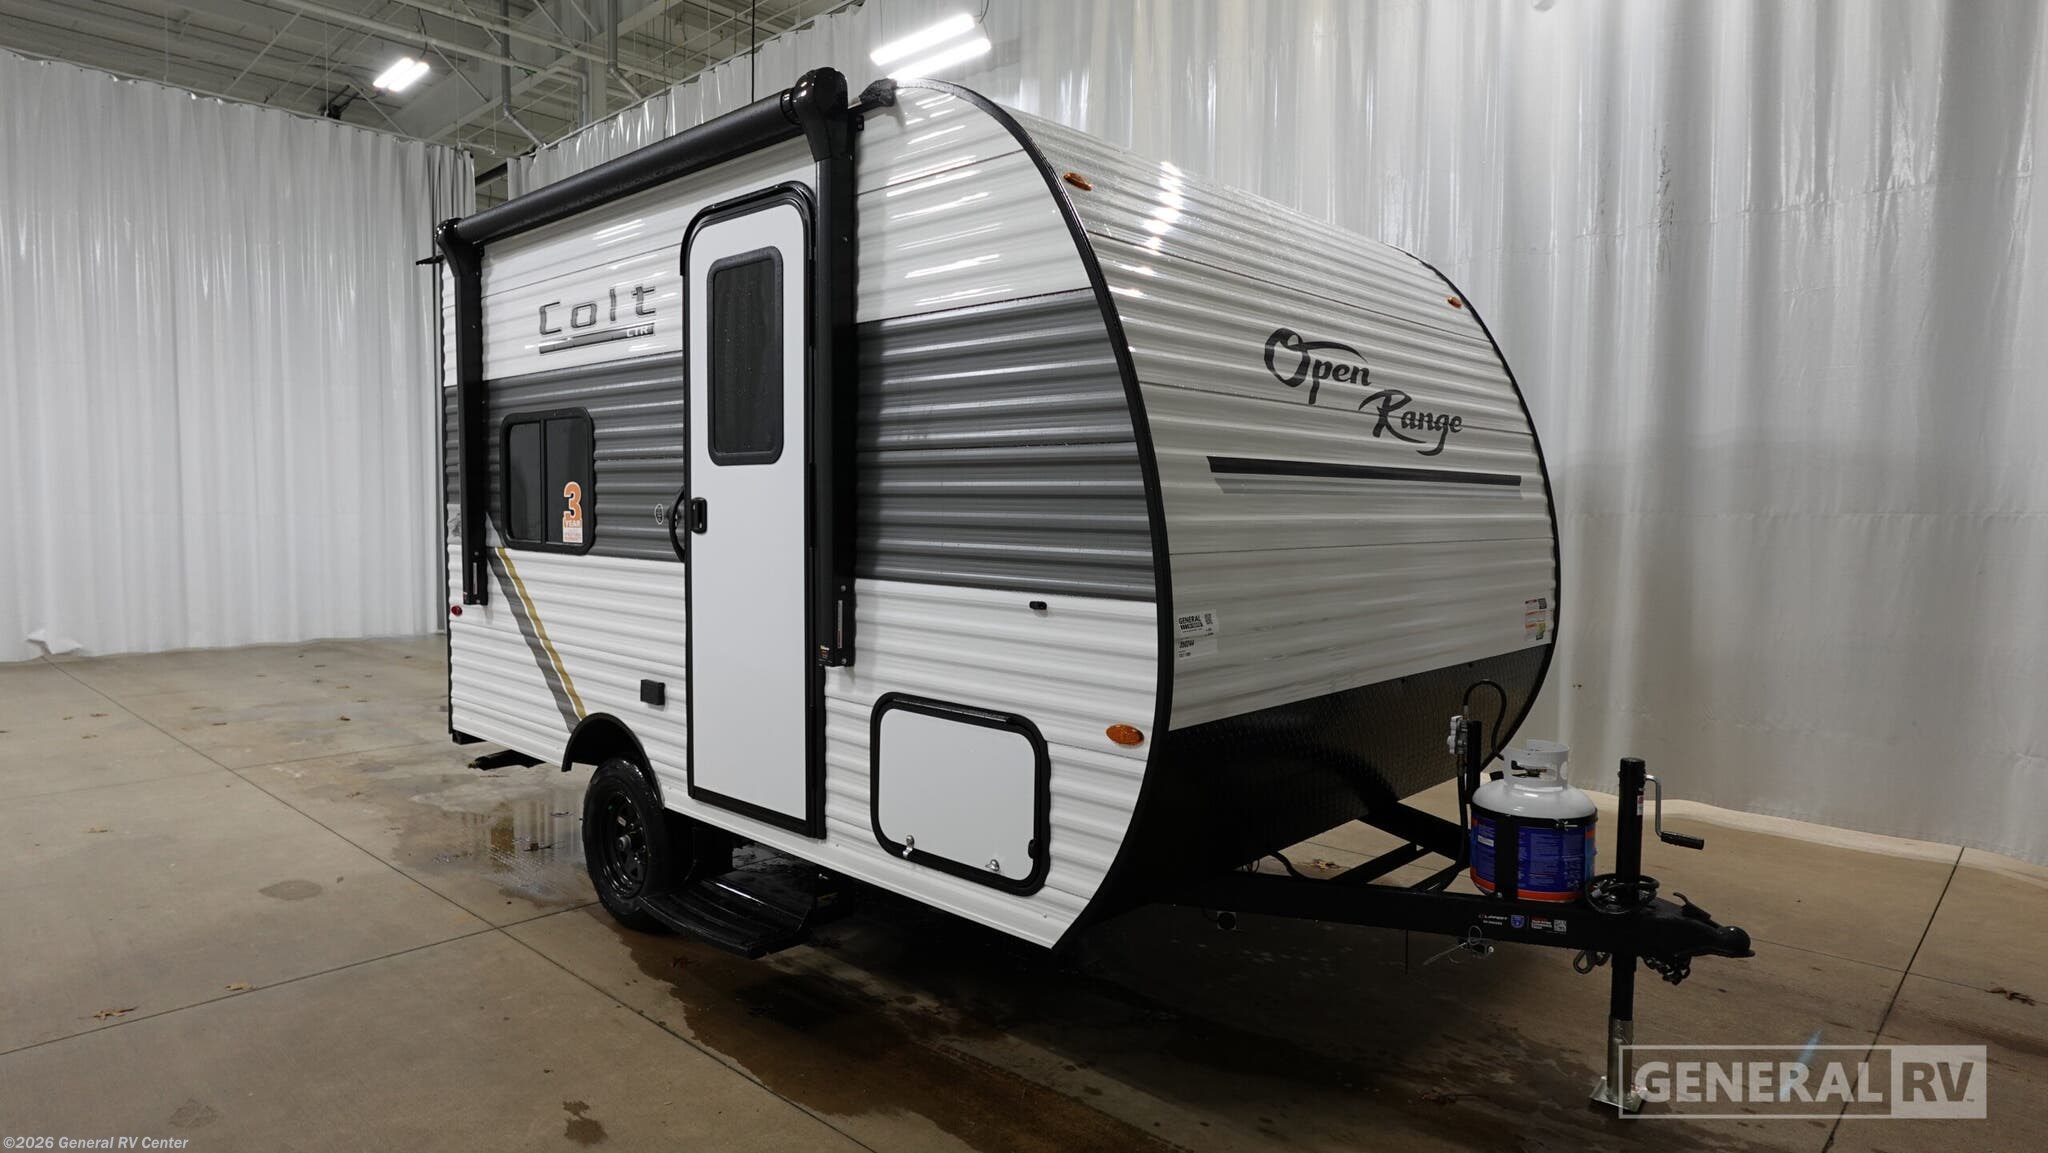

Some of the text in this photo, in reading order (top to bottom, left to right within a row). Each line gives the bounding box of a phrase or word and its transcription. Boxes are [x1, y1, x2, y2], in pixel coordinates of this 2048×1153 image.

[539, 286, 656, 335] Colt
[1264, 328, 1372, 405] Open
[1358, 389, 1463, 456] Range
[563, 481, 582, 520] 3
